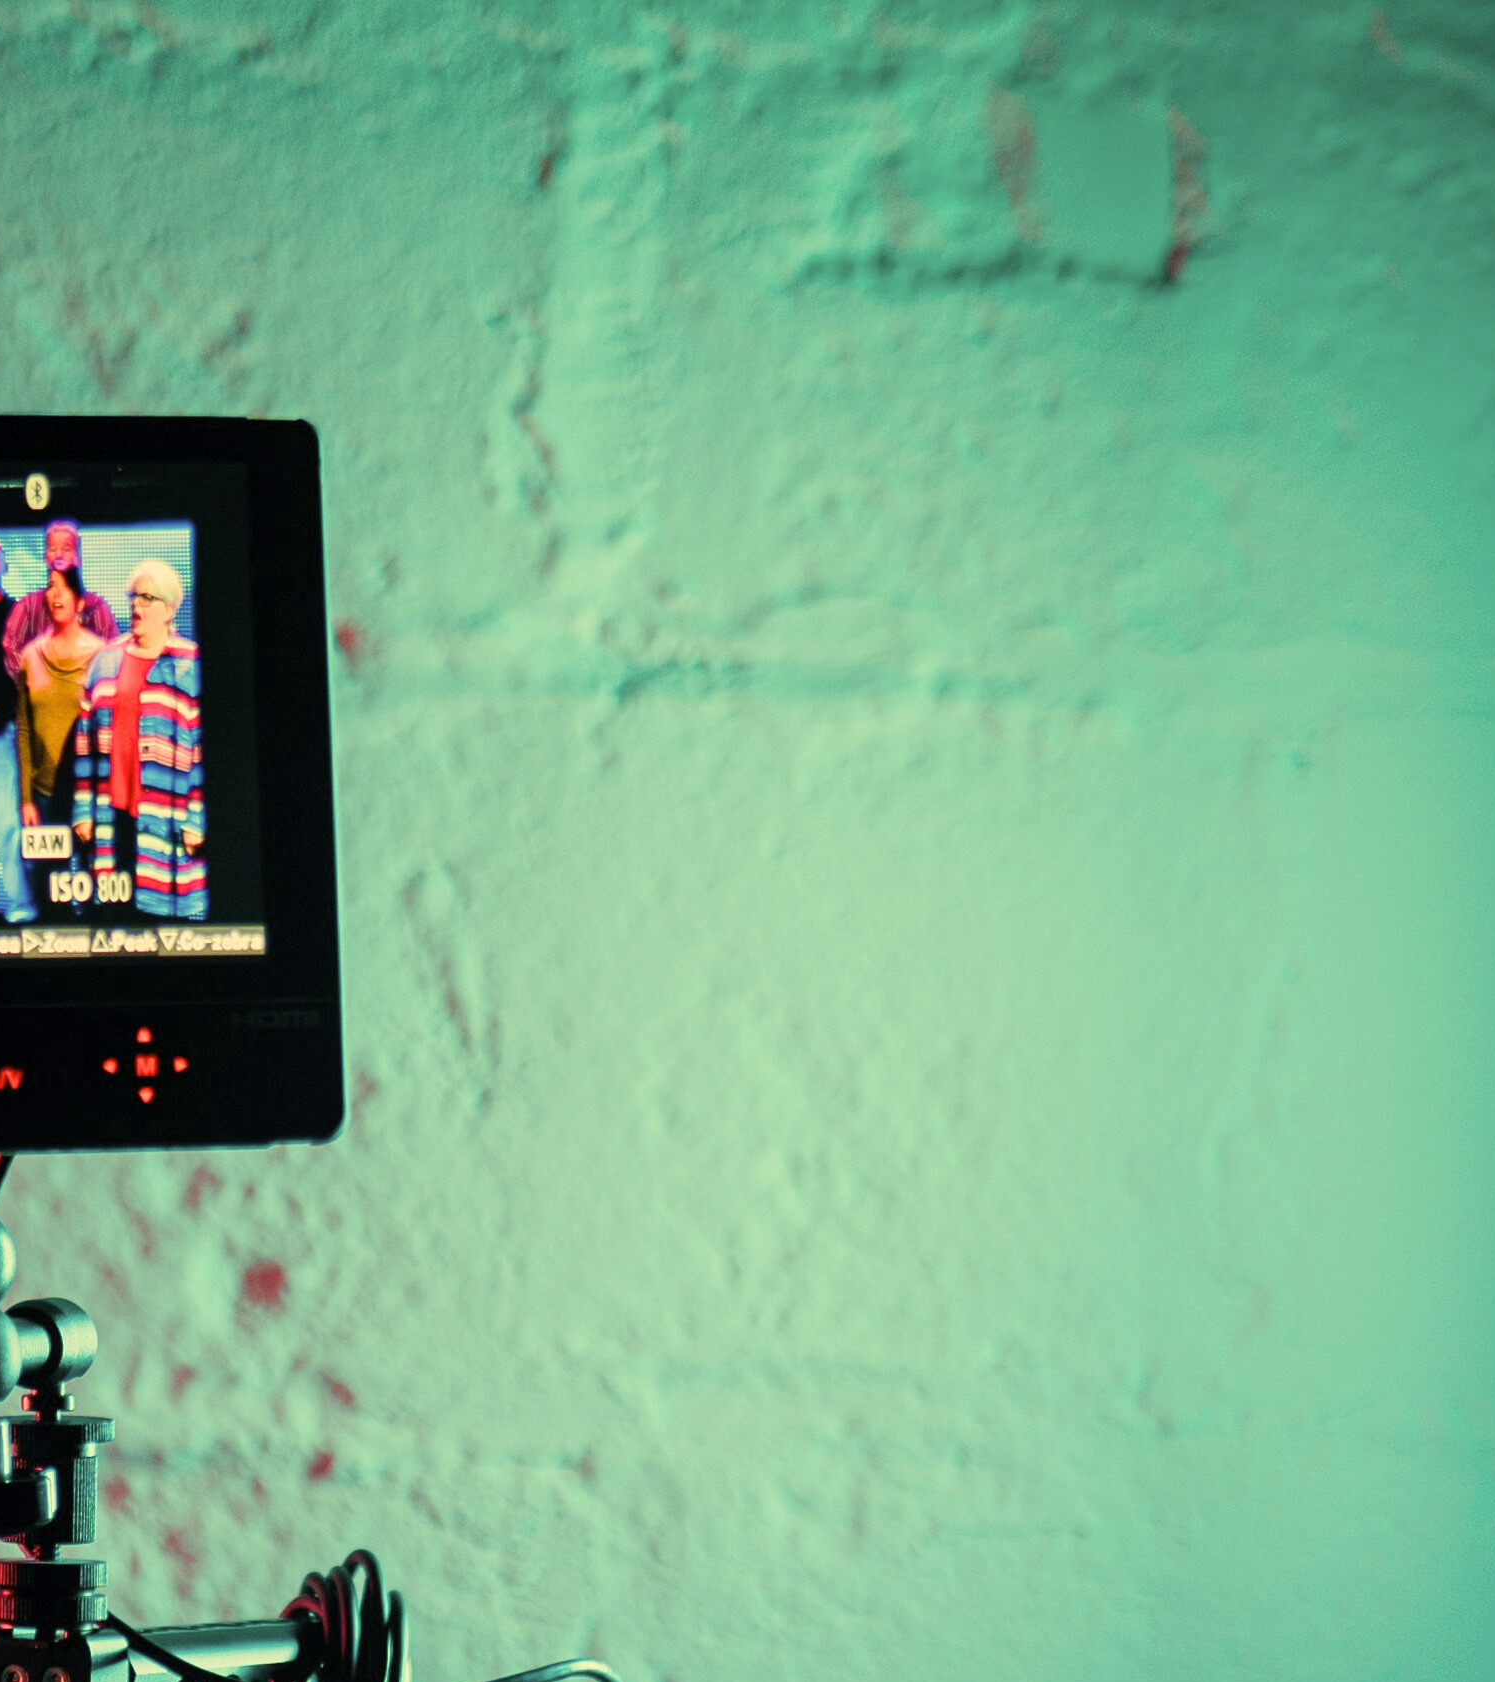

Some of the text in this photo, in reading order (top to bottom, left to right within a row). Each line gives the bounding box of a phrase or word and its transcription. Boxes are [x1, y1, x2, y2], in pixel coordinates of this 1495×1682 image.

[25, 833, 65, 848] RAW
[49, 871, 133, 903] ISO 800
[135, 1053, 159, 1077] M
